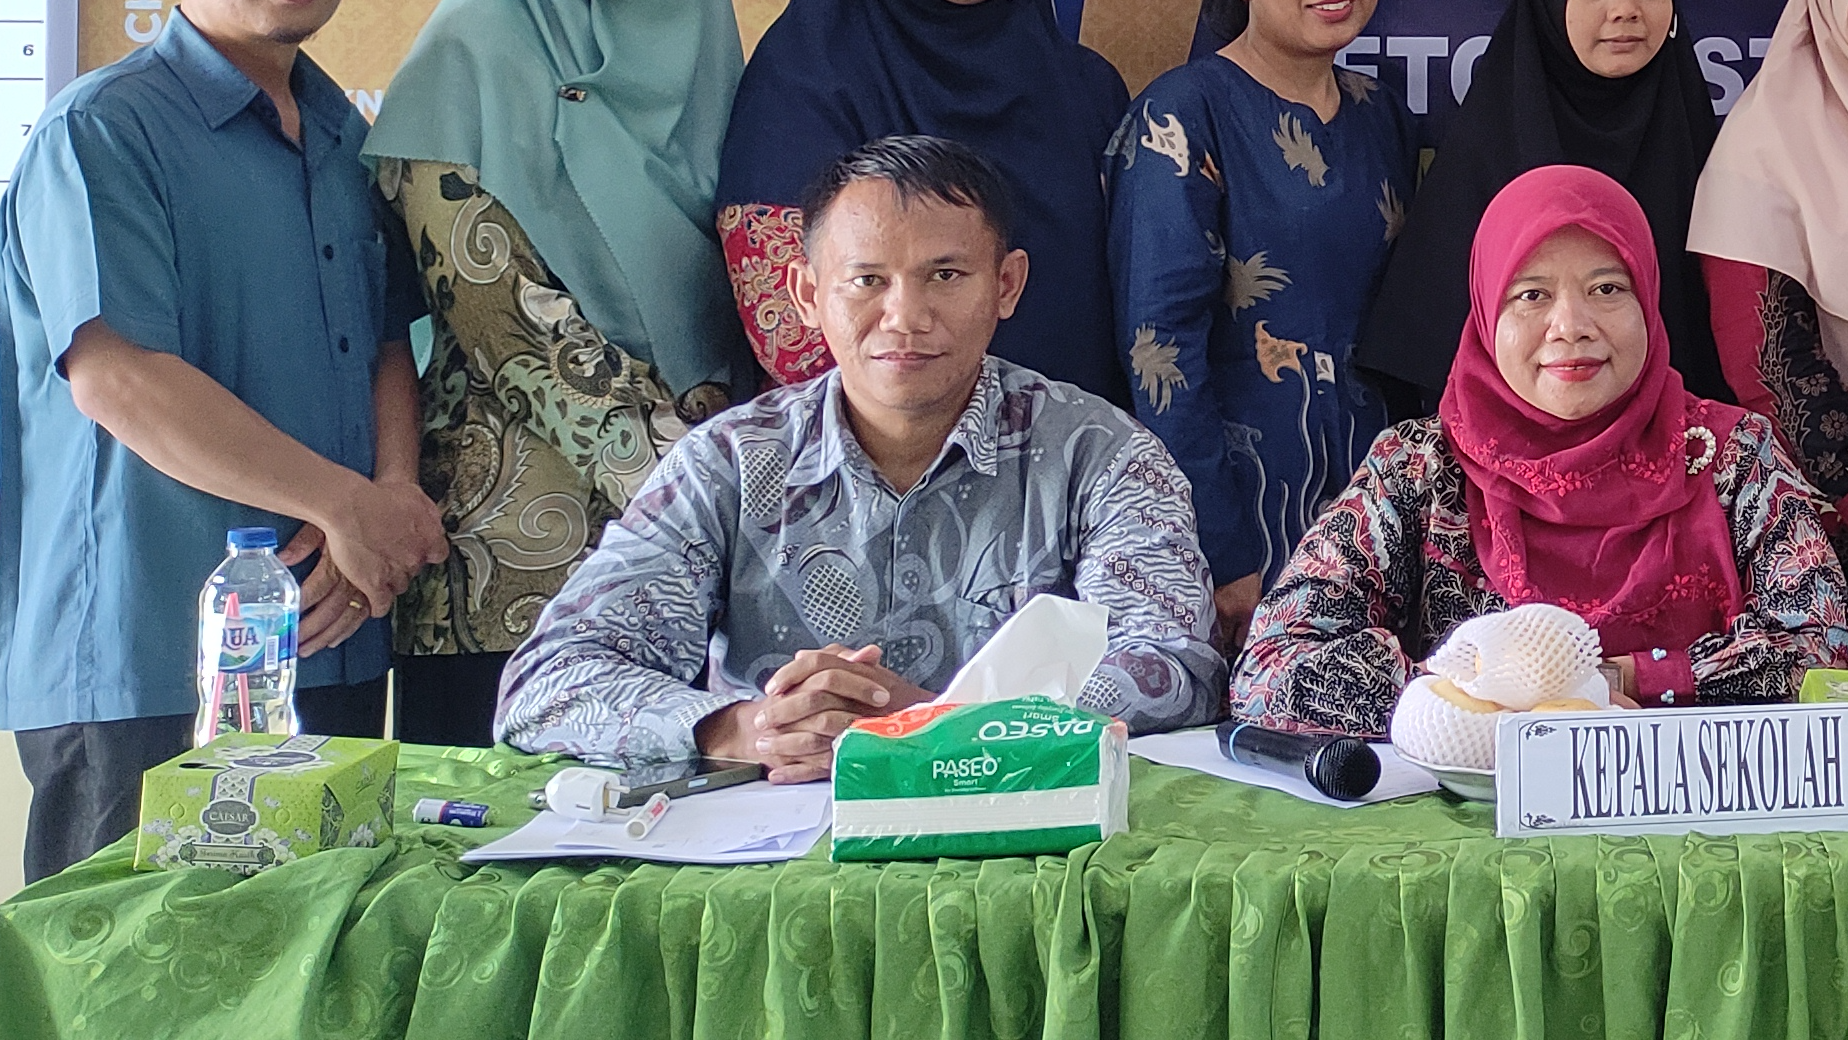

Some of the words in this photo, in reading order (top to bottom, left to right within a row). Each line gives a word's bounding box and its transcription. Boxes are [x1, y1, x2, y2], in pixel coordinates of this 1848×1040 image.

[23, 45, 34, 56] 6
[21, 124, 32, 136] 7
[978, 720, 1095, 741] PASEO
[933, 756, 998, 779] PASEO
[1570, 721, 1692, 820] KEPALA
[1698, 715, 1845, 815] SEKOLAH
[209, 812, 249, 823] CAESAR
